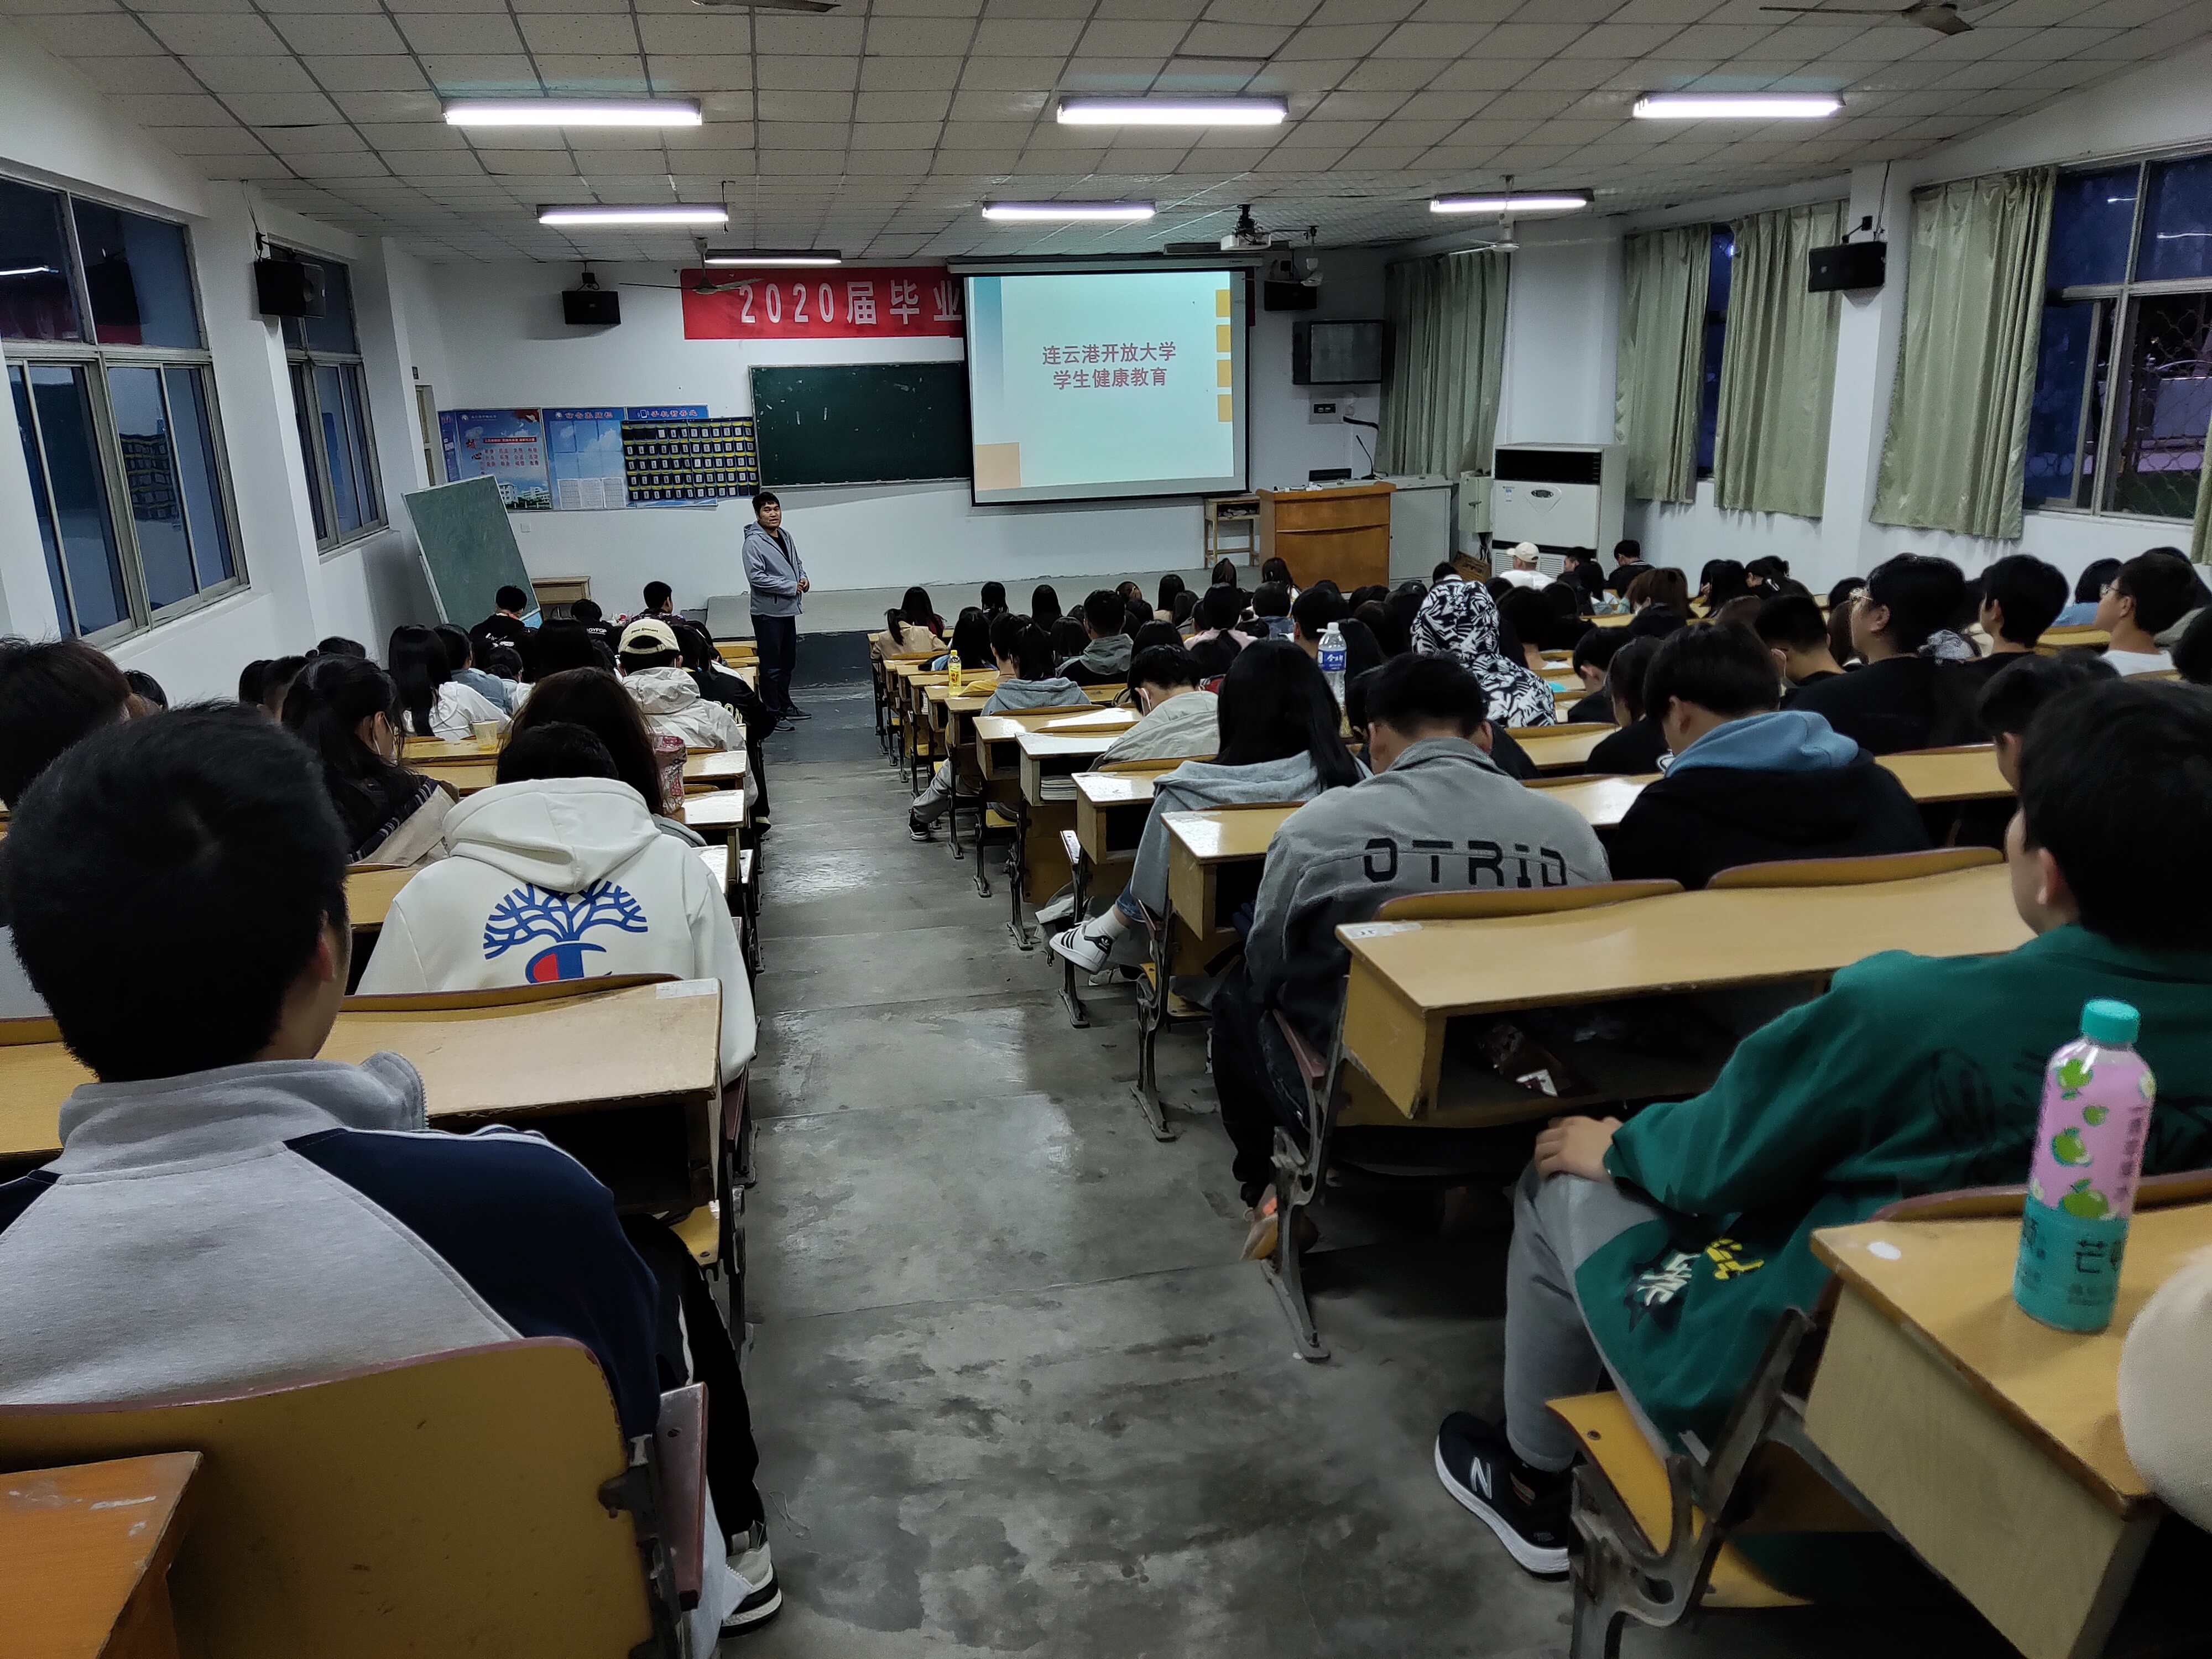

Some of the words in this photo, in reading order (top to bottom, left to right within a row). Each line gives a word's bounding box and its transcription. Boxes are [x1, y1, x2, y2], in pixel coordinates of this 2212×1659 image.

[739, 279, 962, 325] 2020届毕业
[1042, 341, 1177, 365] 连云港开放大学
[1053, 366, 1167, 390] 学生健康教育
